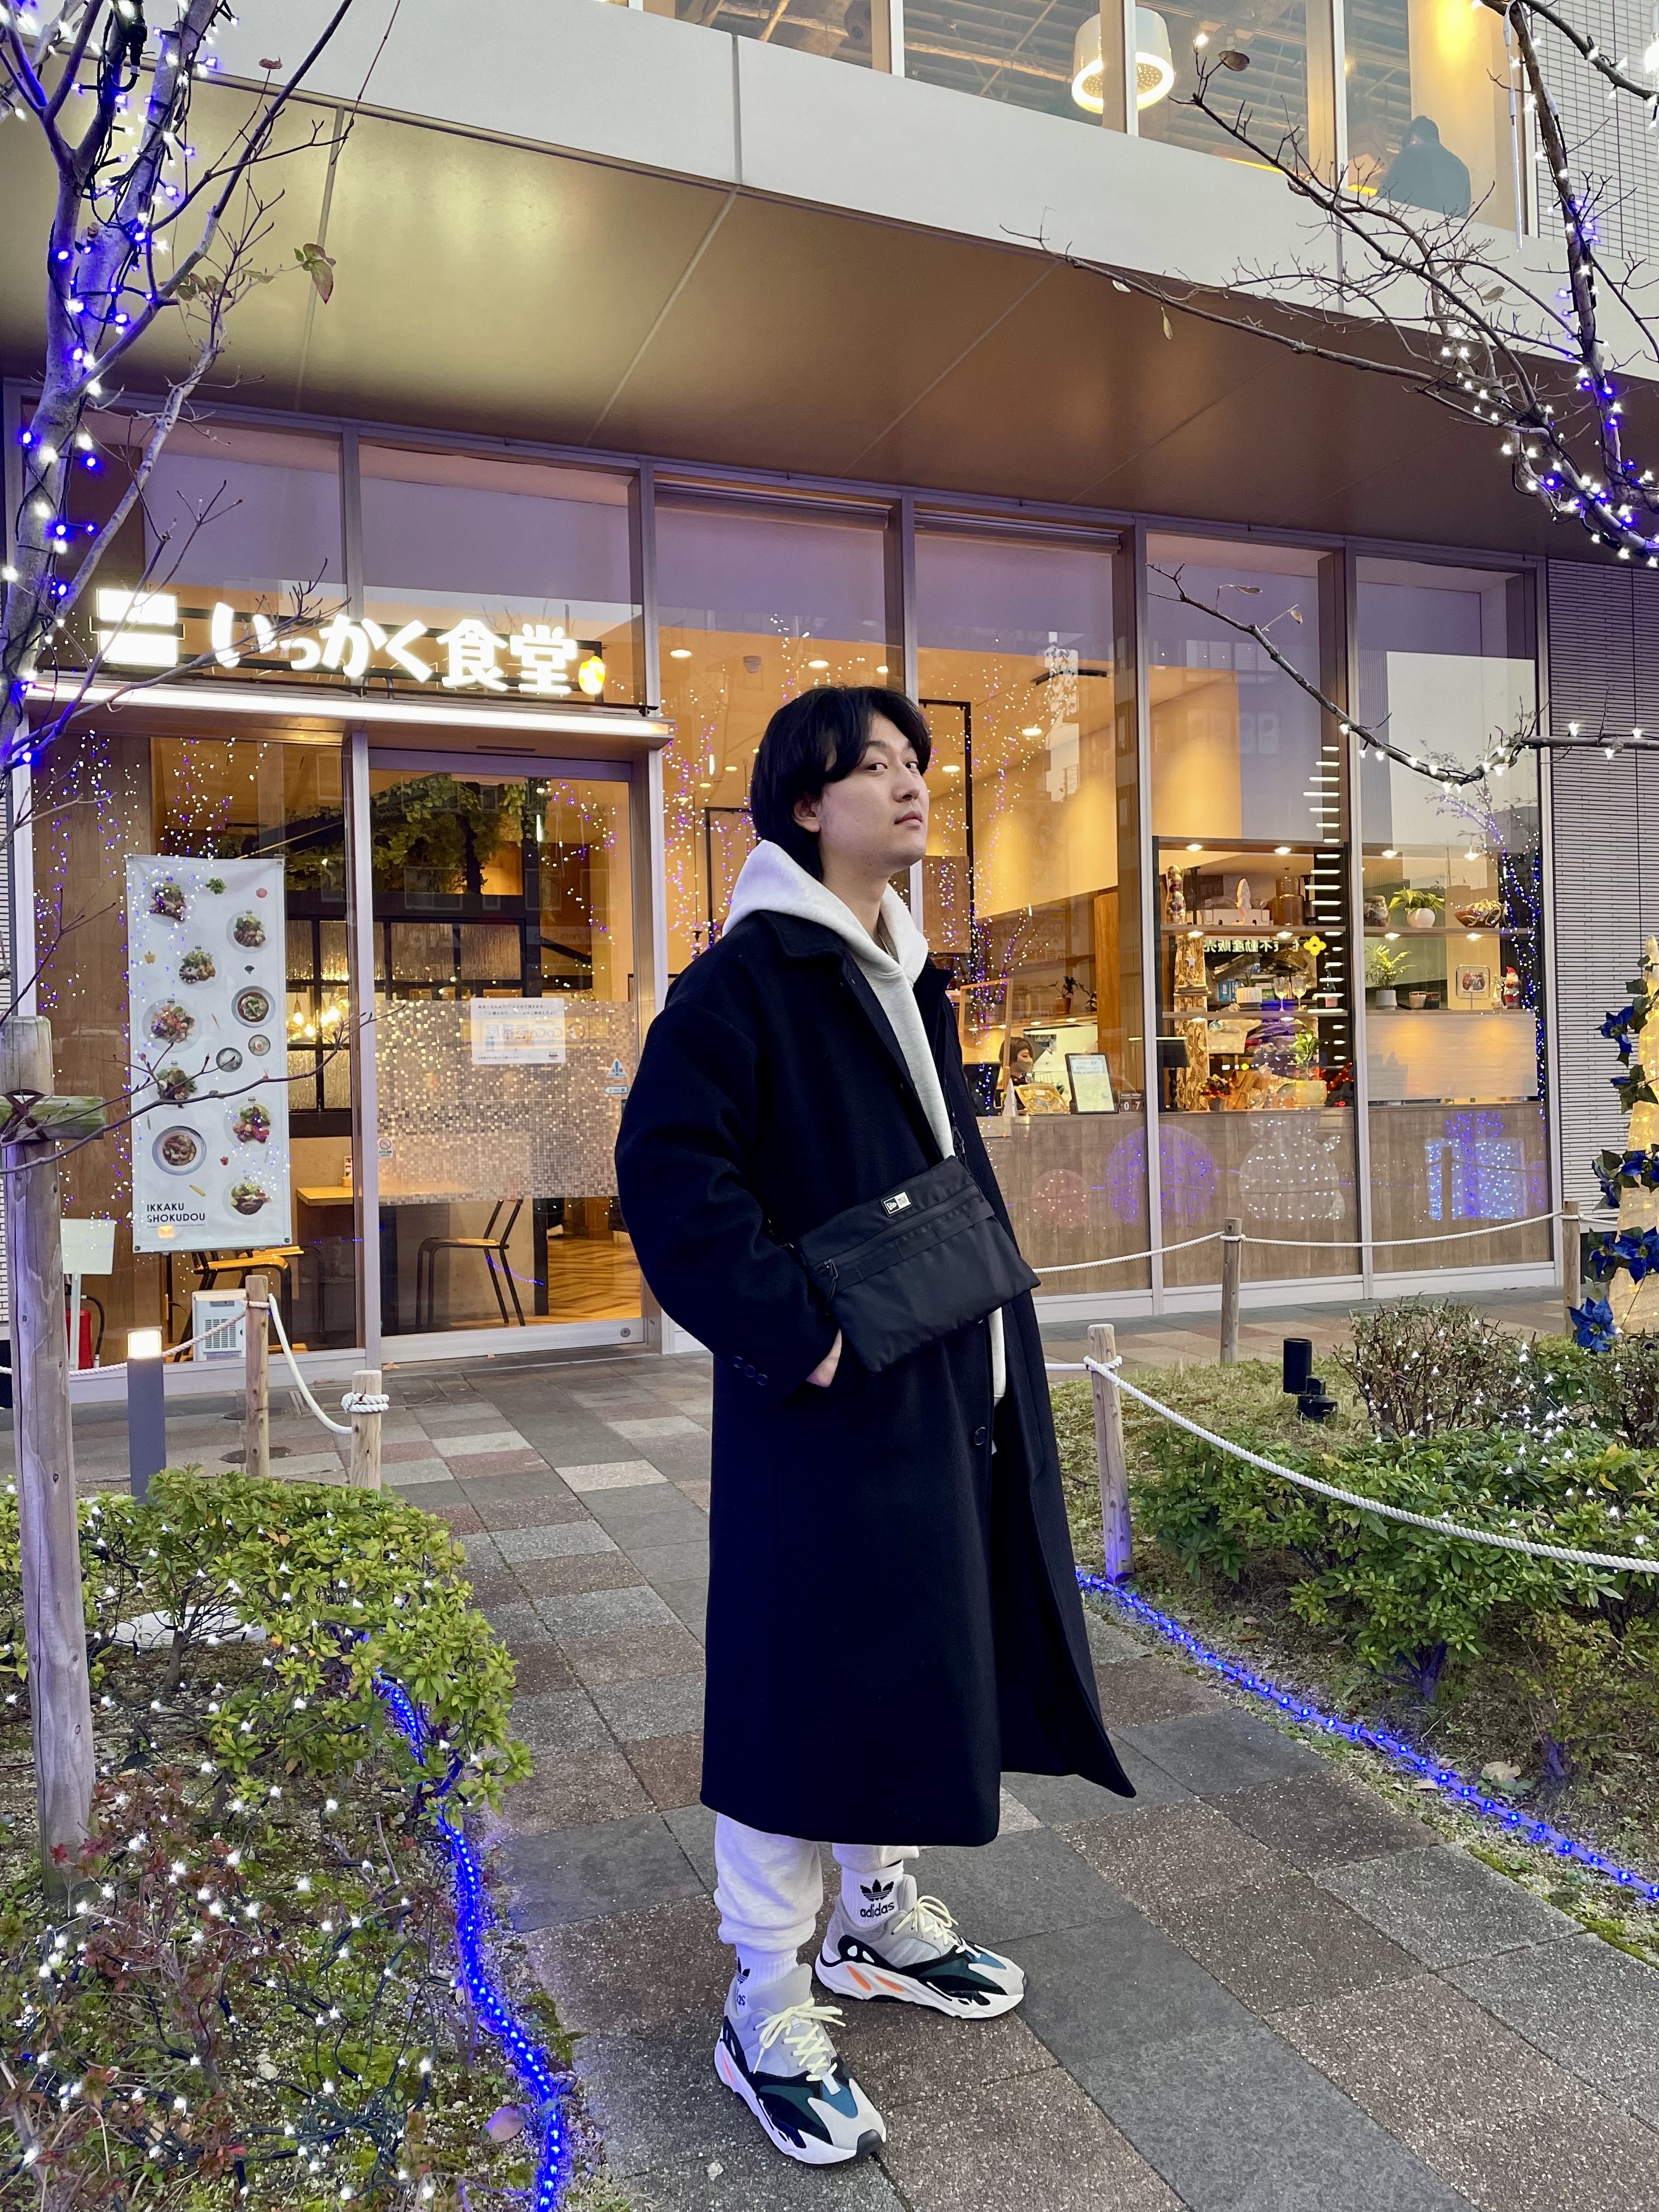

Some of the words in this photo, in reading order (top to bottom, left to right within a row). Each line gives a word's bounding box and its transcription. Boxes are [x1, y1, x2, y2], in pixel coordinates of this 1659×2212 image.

[211, 601, 578, 695] いっかく食堂
[146, 1203, 184, 1212] IKKAKU
[146, 1213, 205, 1223] SHOKUDOU
[860, 1900, 895, 1918] adidas
